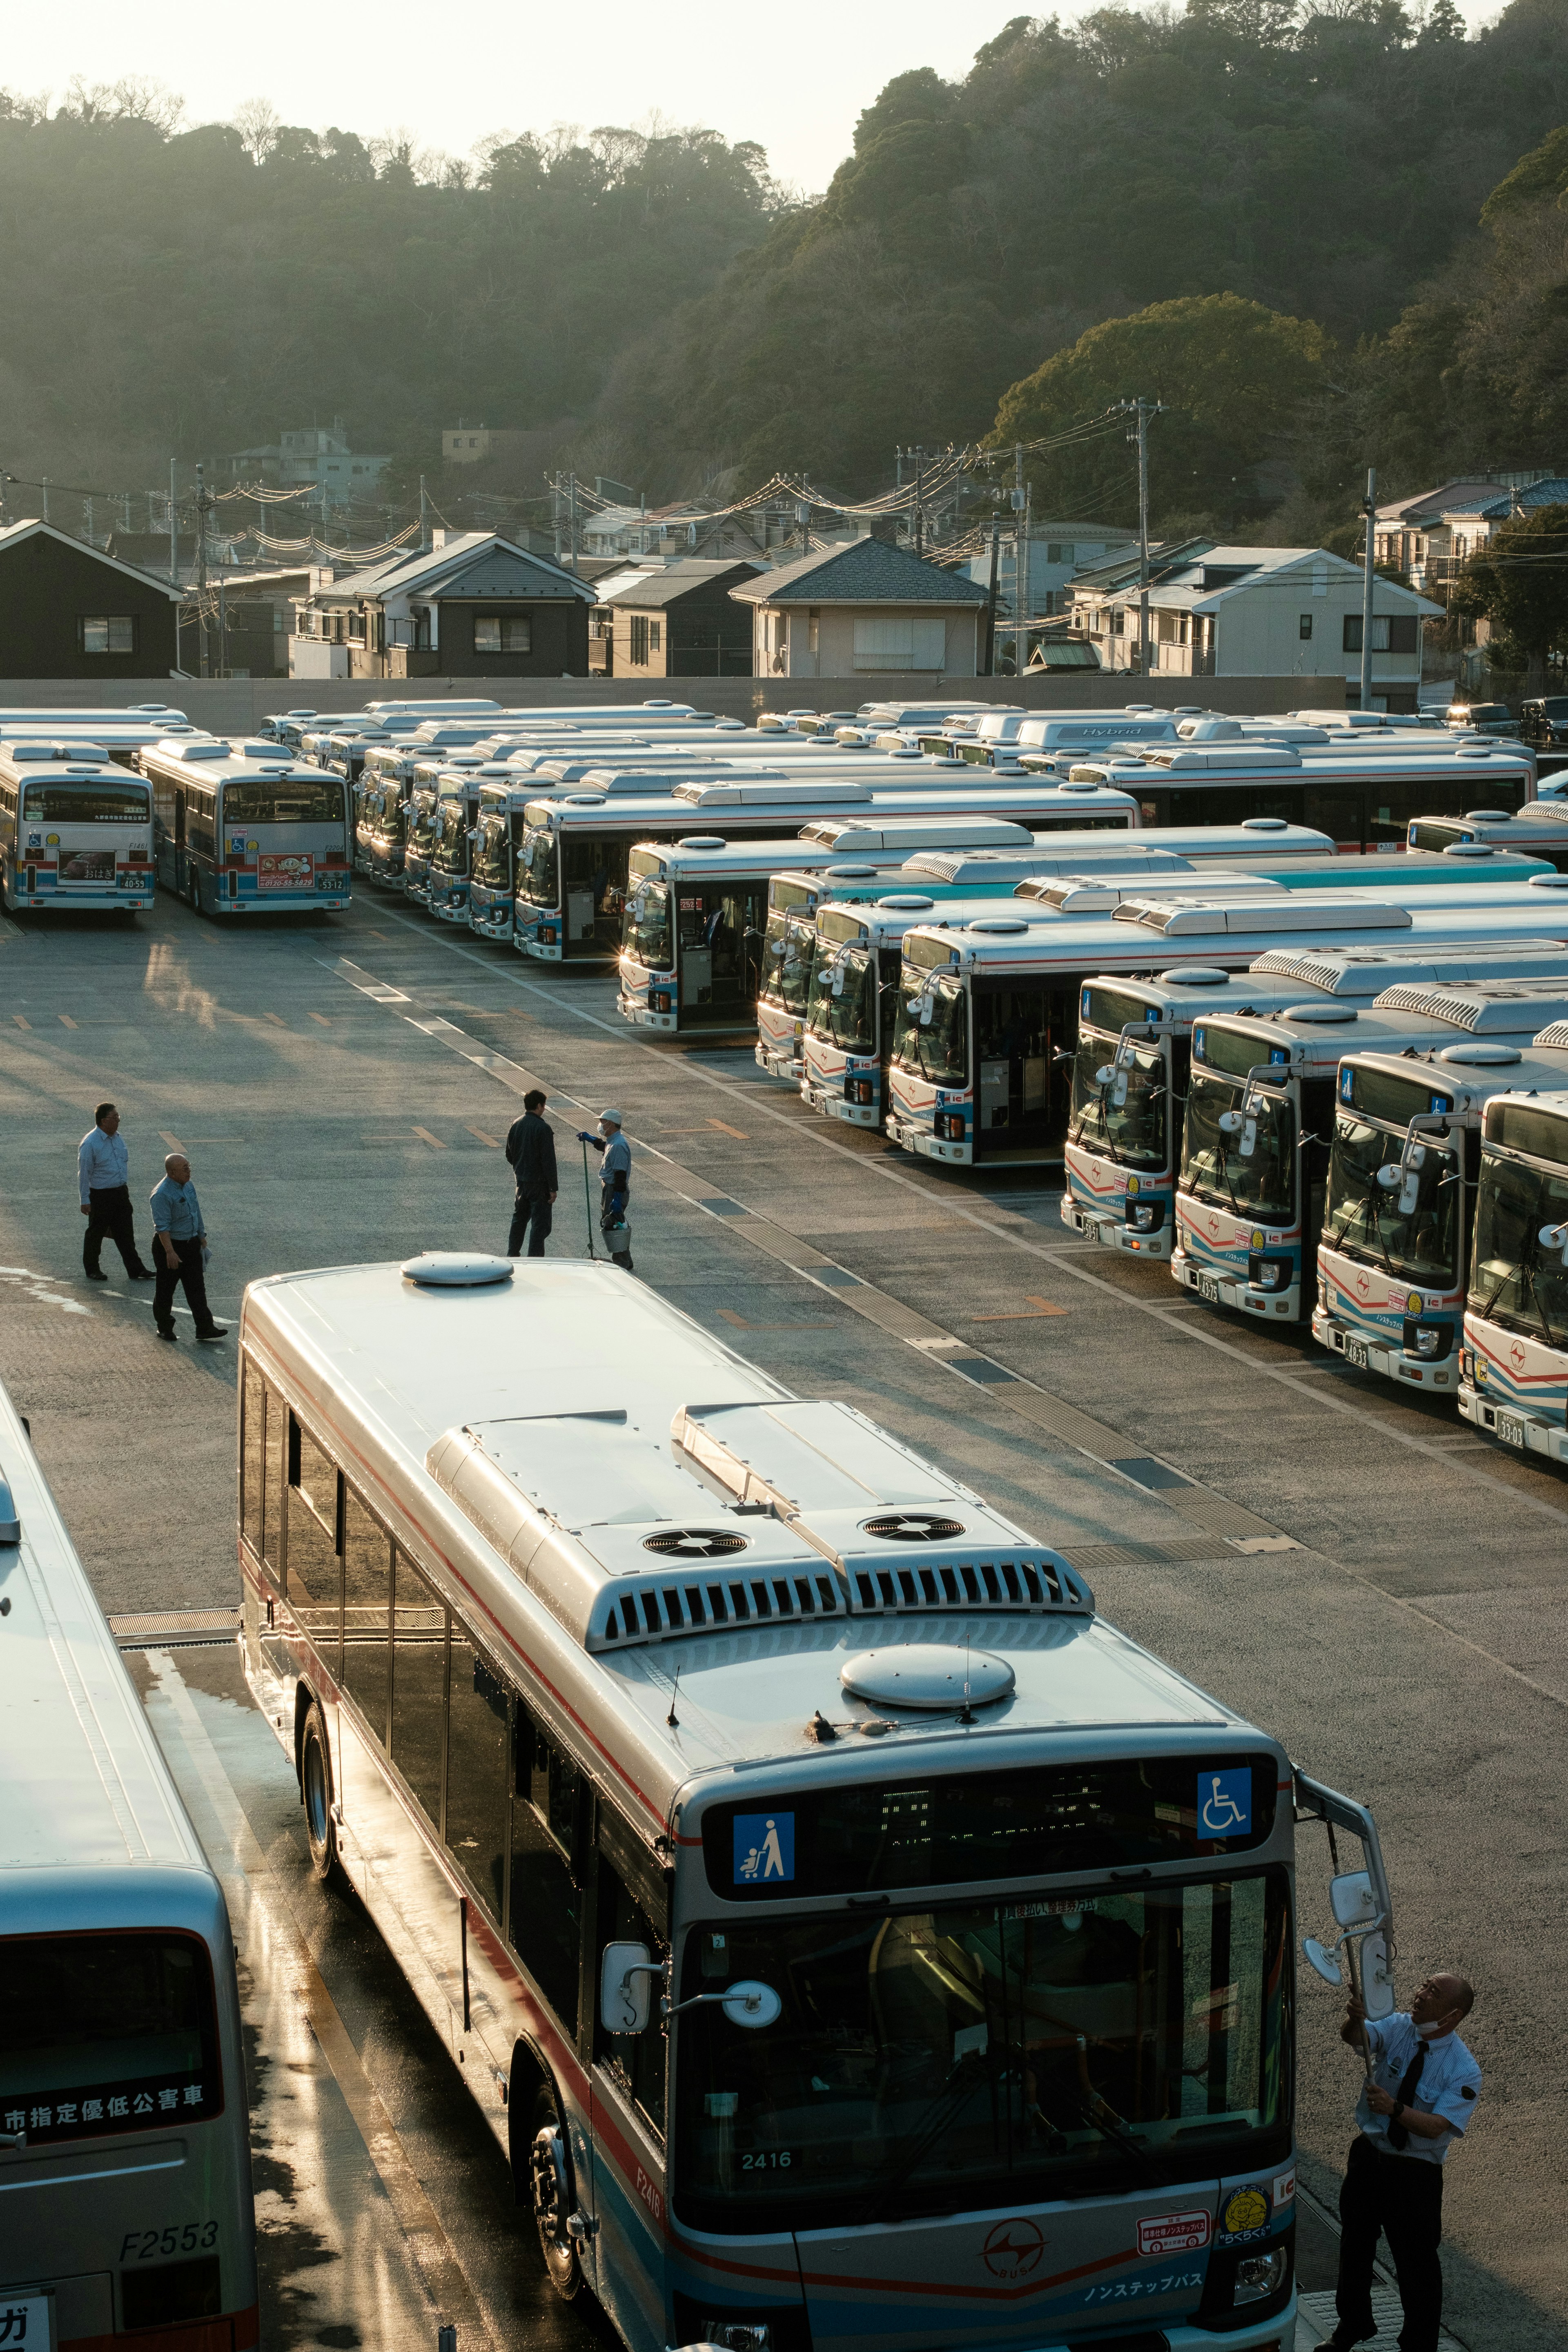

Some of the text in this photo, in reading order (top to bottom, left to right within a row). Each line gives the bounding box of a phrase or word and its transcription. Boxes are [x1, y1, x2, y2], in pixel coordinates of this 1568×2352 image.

[1082, 728, 1143, 736] Hybrid
[84, 869, 113, 879] おはぎ
[904, 1135, 914, 1151] 32-75
[1106, 1196, 1125, 1208] ノンステップバス
[1086, 1223, 1098, 1241] 50-51
[1225, 1252, 1249, 1266] ノンステップバス
[1202, 1281, 1217, 1301] 43-75
[1376, 1314, 1403, 1330] ノンステップバス
[1348, 1344, 1366, 1367] 48-33
[1501, 1421, 1522, 1446] 33-03
[5, 2085, 203, 2130] 市指定優低公害車
[742, 2152, 791, 2169] 2416
[637, 2166, 660, 2218] F2416
[1230, 2185, 1265, 2201] ノンステップバス
[1144, 2223, 1205, 2239] 標準仕様ノンステップバス
[119, 2220, 219, 2262] F2553
[999, 2267, 1028, 2279] BUS
[1085, 2273, 1203, 2302] ノンステップバス
[0, 2306, 29, 2344] ガ
